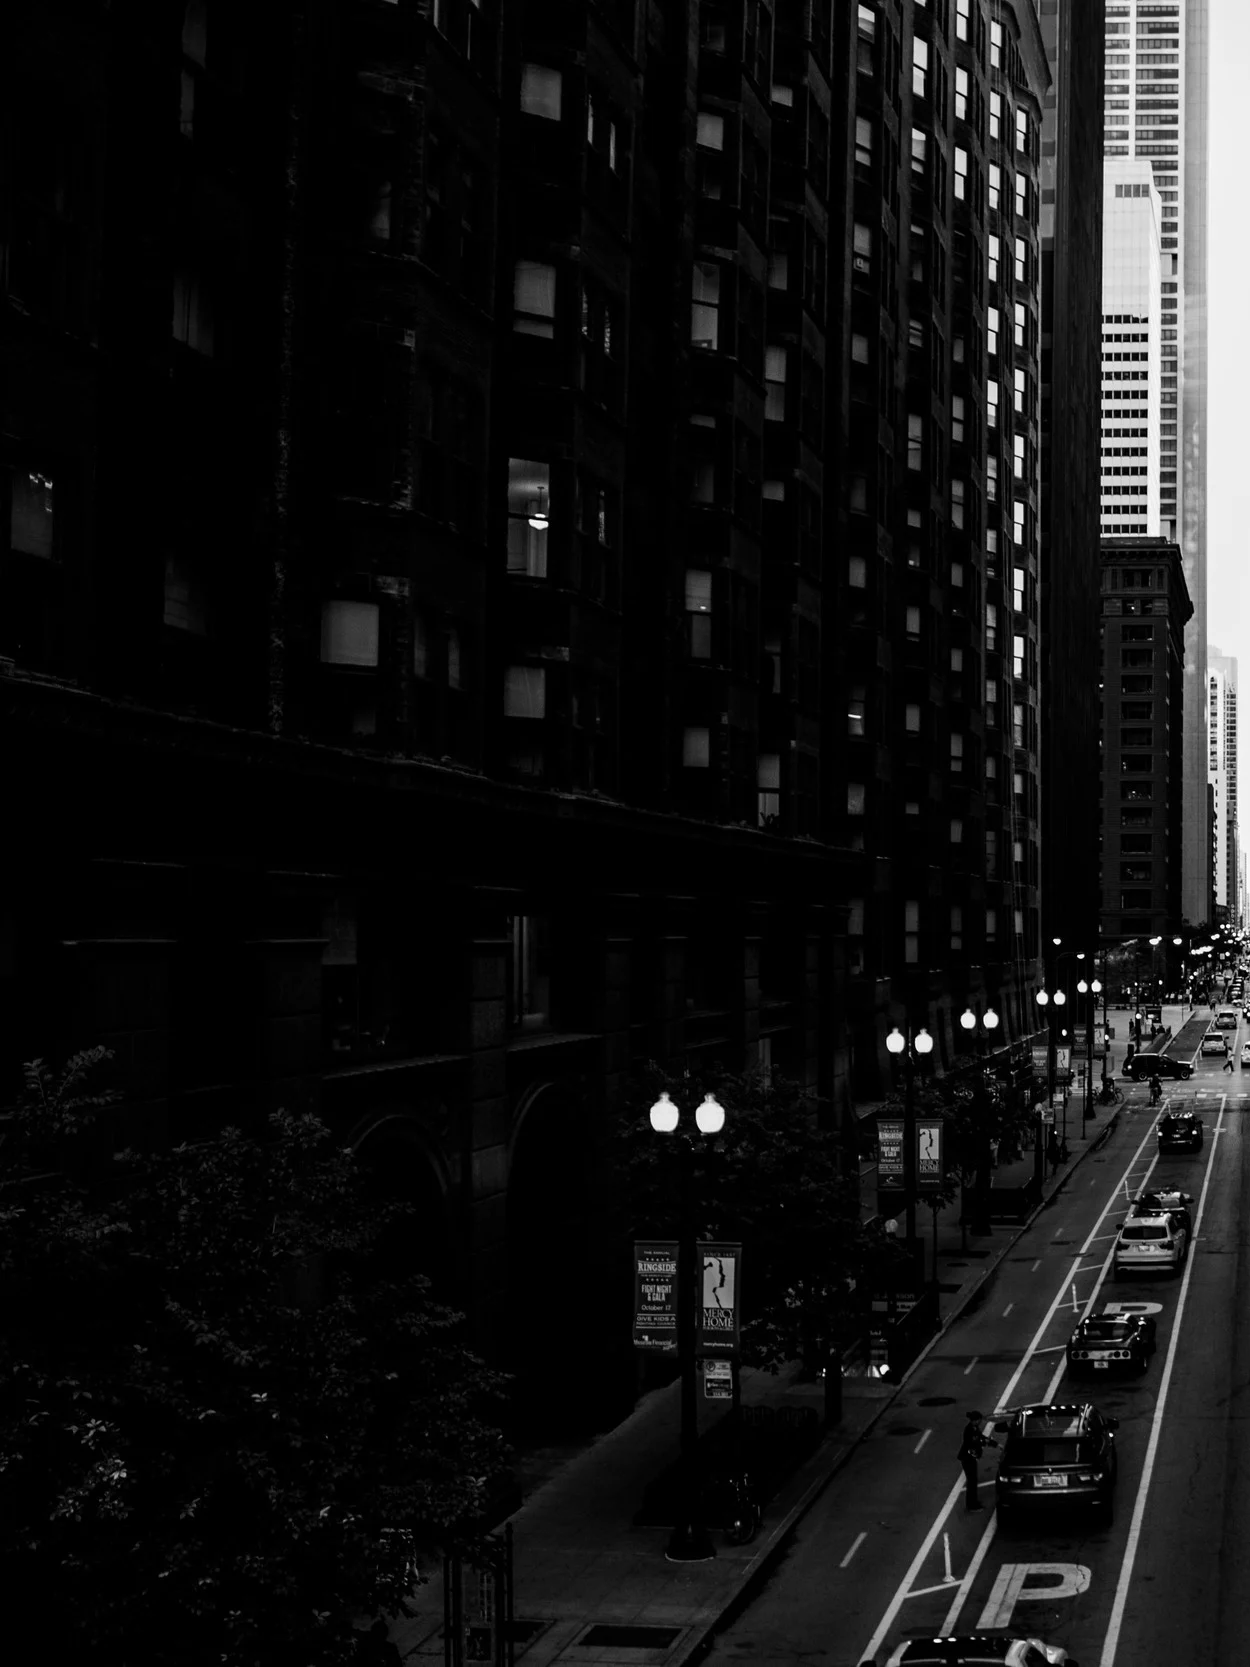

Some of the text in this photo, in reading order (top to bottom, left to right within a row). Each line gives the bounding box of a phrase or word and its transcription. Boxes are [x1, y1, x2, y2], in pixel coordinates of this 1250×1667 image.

[637, 1262, 677, 1272] RINGSIDE
[641, 1284, 672, 1293] FIGHT NIGHT
[652, 1293, 666, 1301] GALA
[703, 1308, 734, 1319] MERCY
[703, 1318, 734, 1328] HOME
[976, 1563, 1092, 1629] P
